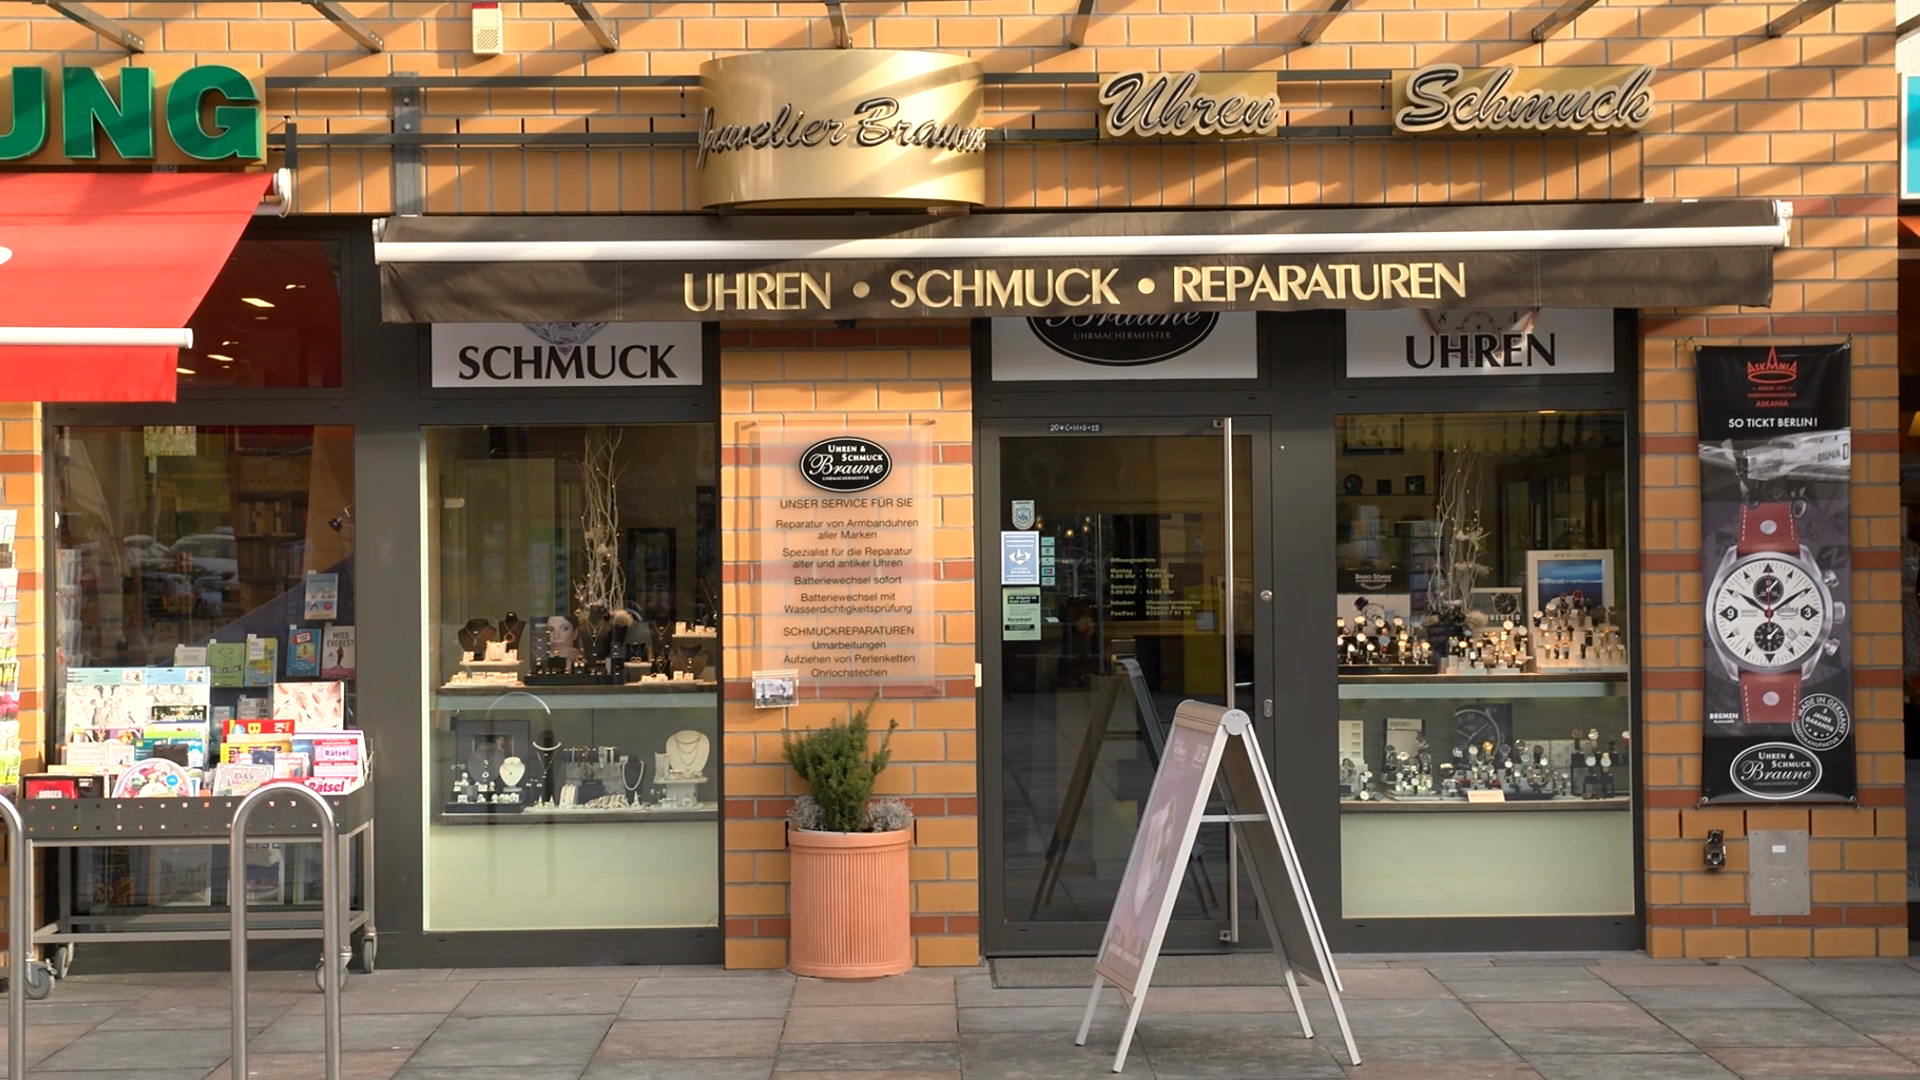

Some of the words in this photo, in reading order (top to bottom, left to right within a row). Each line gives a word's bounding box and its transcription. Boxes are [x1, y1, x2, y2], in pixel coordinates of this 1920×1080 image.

[1102, 71, 1279, 133] Uhren
[1399, 66, 1655, 128] Schmuck
[695, 103, 847, 171] Juwelier
[684, 270, 831, 311] UHREN
[890, 268, 1121, 309] SCHMUCK
[1174, 262, 1466, 302] REPARATUREN
[1073, 331, 1171, 340] UHRMACHERMEISTER
[1405, 333, 1556, 369] UHREN
[458, 344, 678, 380] SCHMUCK
[1728, 418, 1744, 428] SO
[1747, 418, 1775, 428] TICKT
[841, 453, 884, 462] SCHMUCK
[809, 453, 884, 475] Braune
[780, 499, 818, 509] UNSER
[821, 499, 868, 508] SERVICE
[871, 497, 893, 508] FÜR
[896, 498, 914, 507] SIE
[775, 520, 823, 530] Reparatur
[846, 519, 919, 528] Armbanduhren
[818, 531, 837, 540] aller
[840, 530, 877, 539] Marken
[782, 547, 829, 558] Spezialist
[832, 547, 844, 556] für
[847, 547, 862, 556] die
[865, 547, 913, 558] Reparatur
[792, 560, 814, 568] alter
[816, 559, 835, 568] und
[837, 559, 870, 568] antiker
[873, 558, 903, 567] Uhren
[794, 576, 871, 585] Batteriewechsel
[873, 575, 902, 584] sofort
[800, 593, 878, 602] Batteriewechsel
[880, 592, 896, 601] mit
[784, 603, 913, 615] Wasserdichtigkeitsprüfung
[1726, 608, 1734, 618] 9
[1804, 607, 1811, 617] 3
[332, 631, 349, 640] MISS
[783, 626, 915, 636] SCHMUCKREPARATUREN
[326, 639, 355, 648] EVEREST
[811, 641, 886, 651] Umarbeitungen
[783, 655, 831, 664] Aufziehen
[854, 654, 915, 663] Perlenketten
[811, 668, 888, 678] Ohrlochstechen
[325, 749, 349, 757] Rätsel
[1758, 752, 1786, 760] UHREN
[1789, 752, 1795, 760] &
[1771, 760, 1811, 768] SCHMUCK
[1741, 760, 1812, 780] Braune
[309, 780, 345, 793] Rätsel
